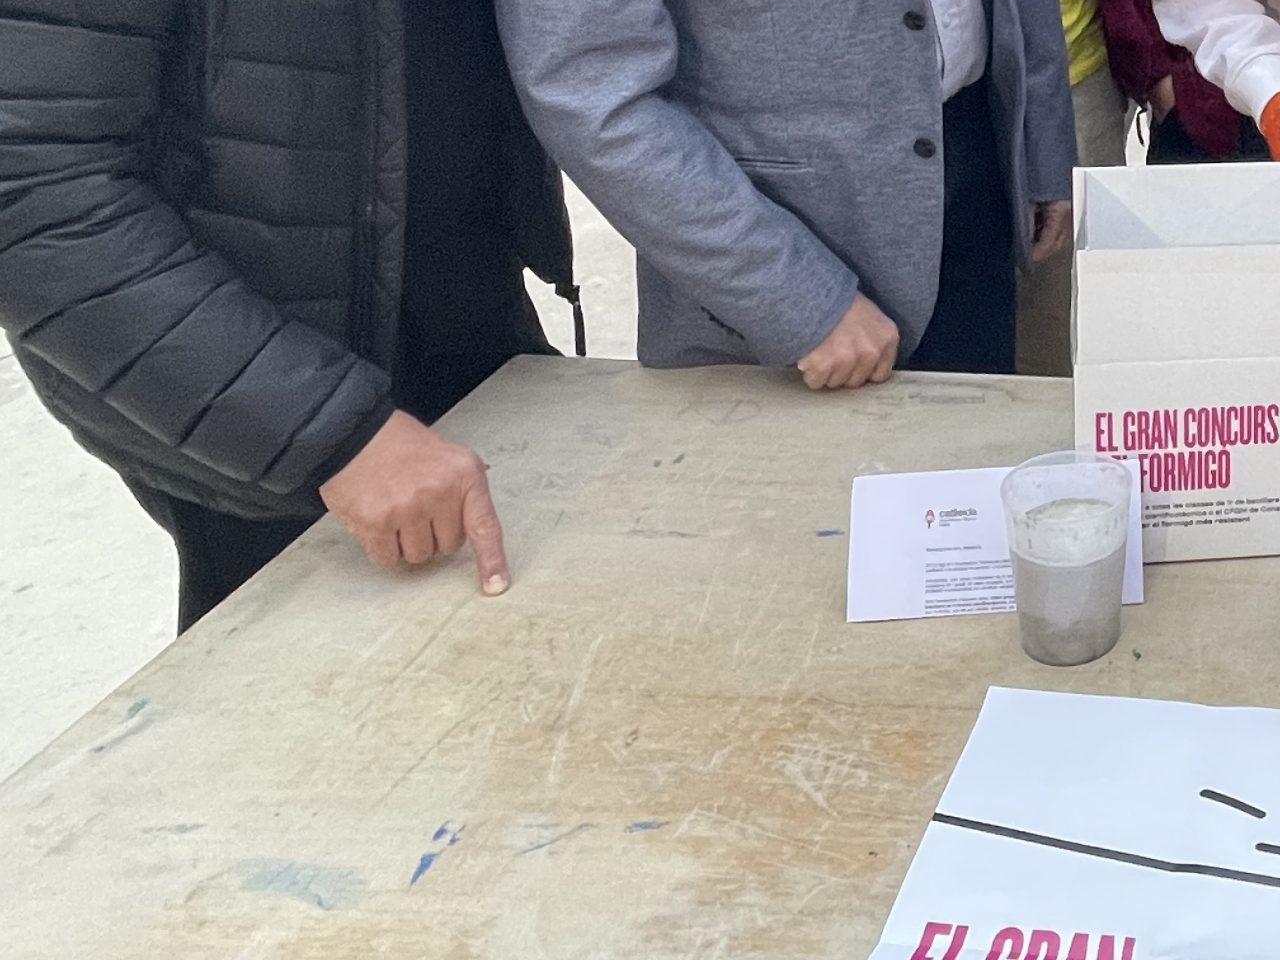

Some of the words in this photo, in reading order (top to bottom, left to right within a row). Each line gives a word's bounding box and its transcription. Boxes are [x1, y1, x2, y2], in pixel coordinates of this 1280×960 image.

[1095, 412, 1118, 452] EL
[1123, 409, 1178, 451] GRAN
[1183, 404, 1280, 448] CONCURS
[1139, 446, 1231, 493] FORMIGÓ
